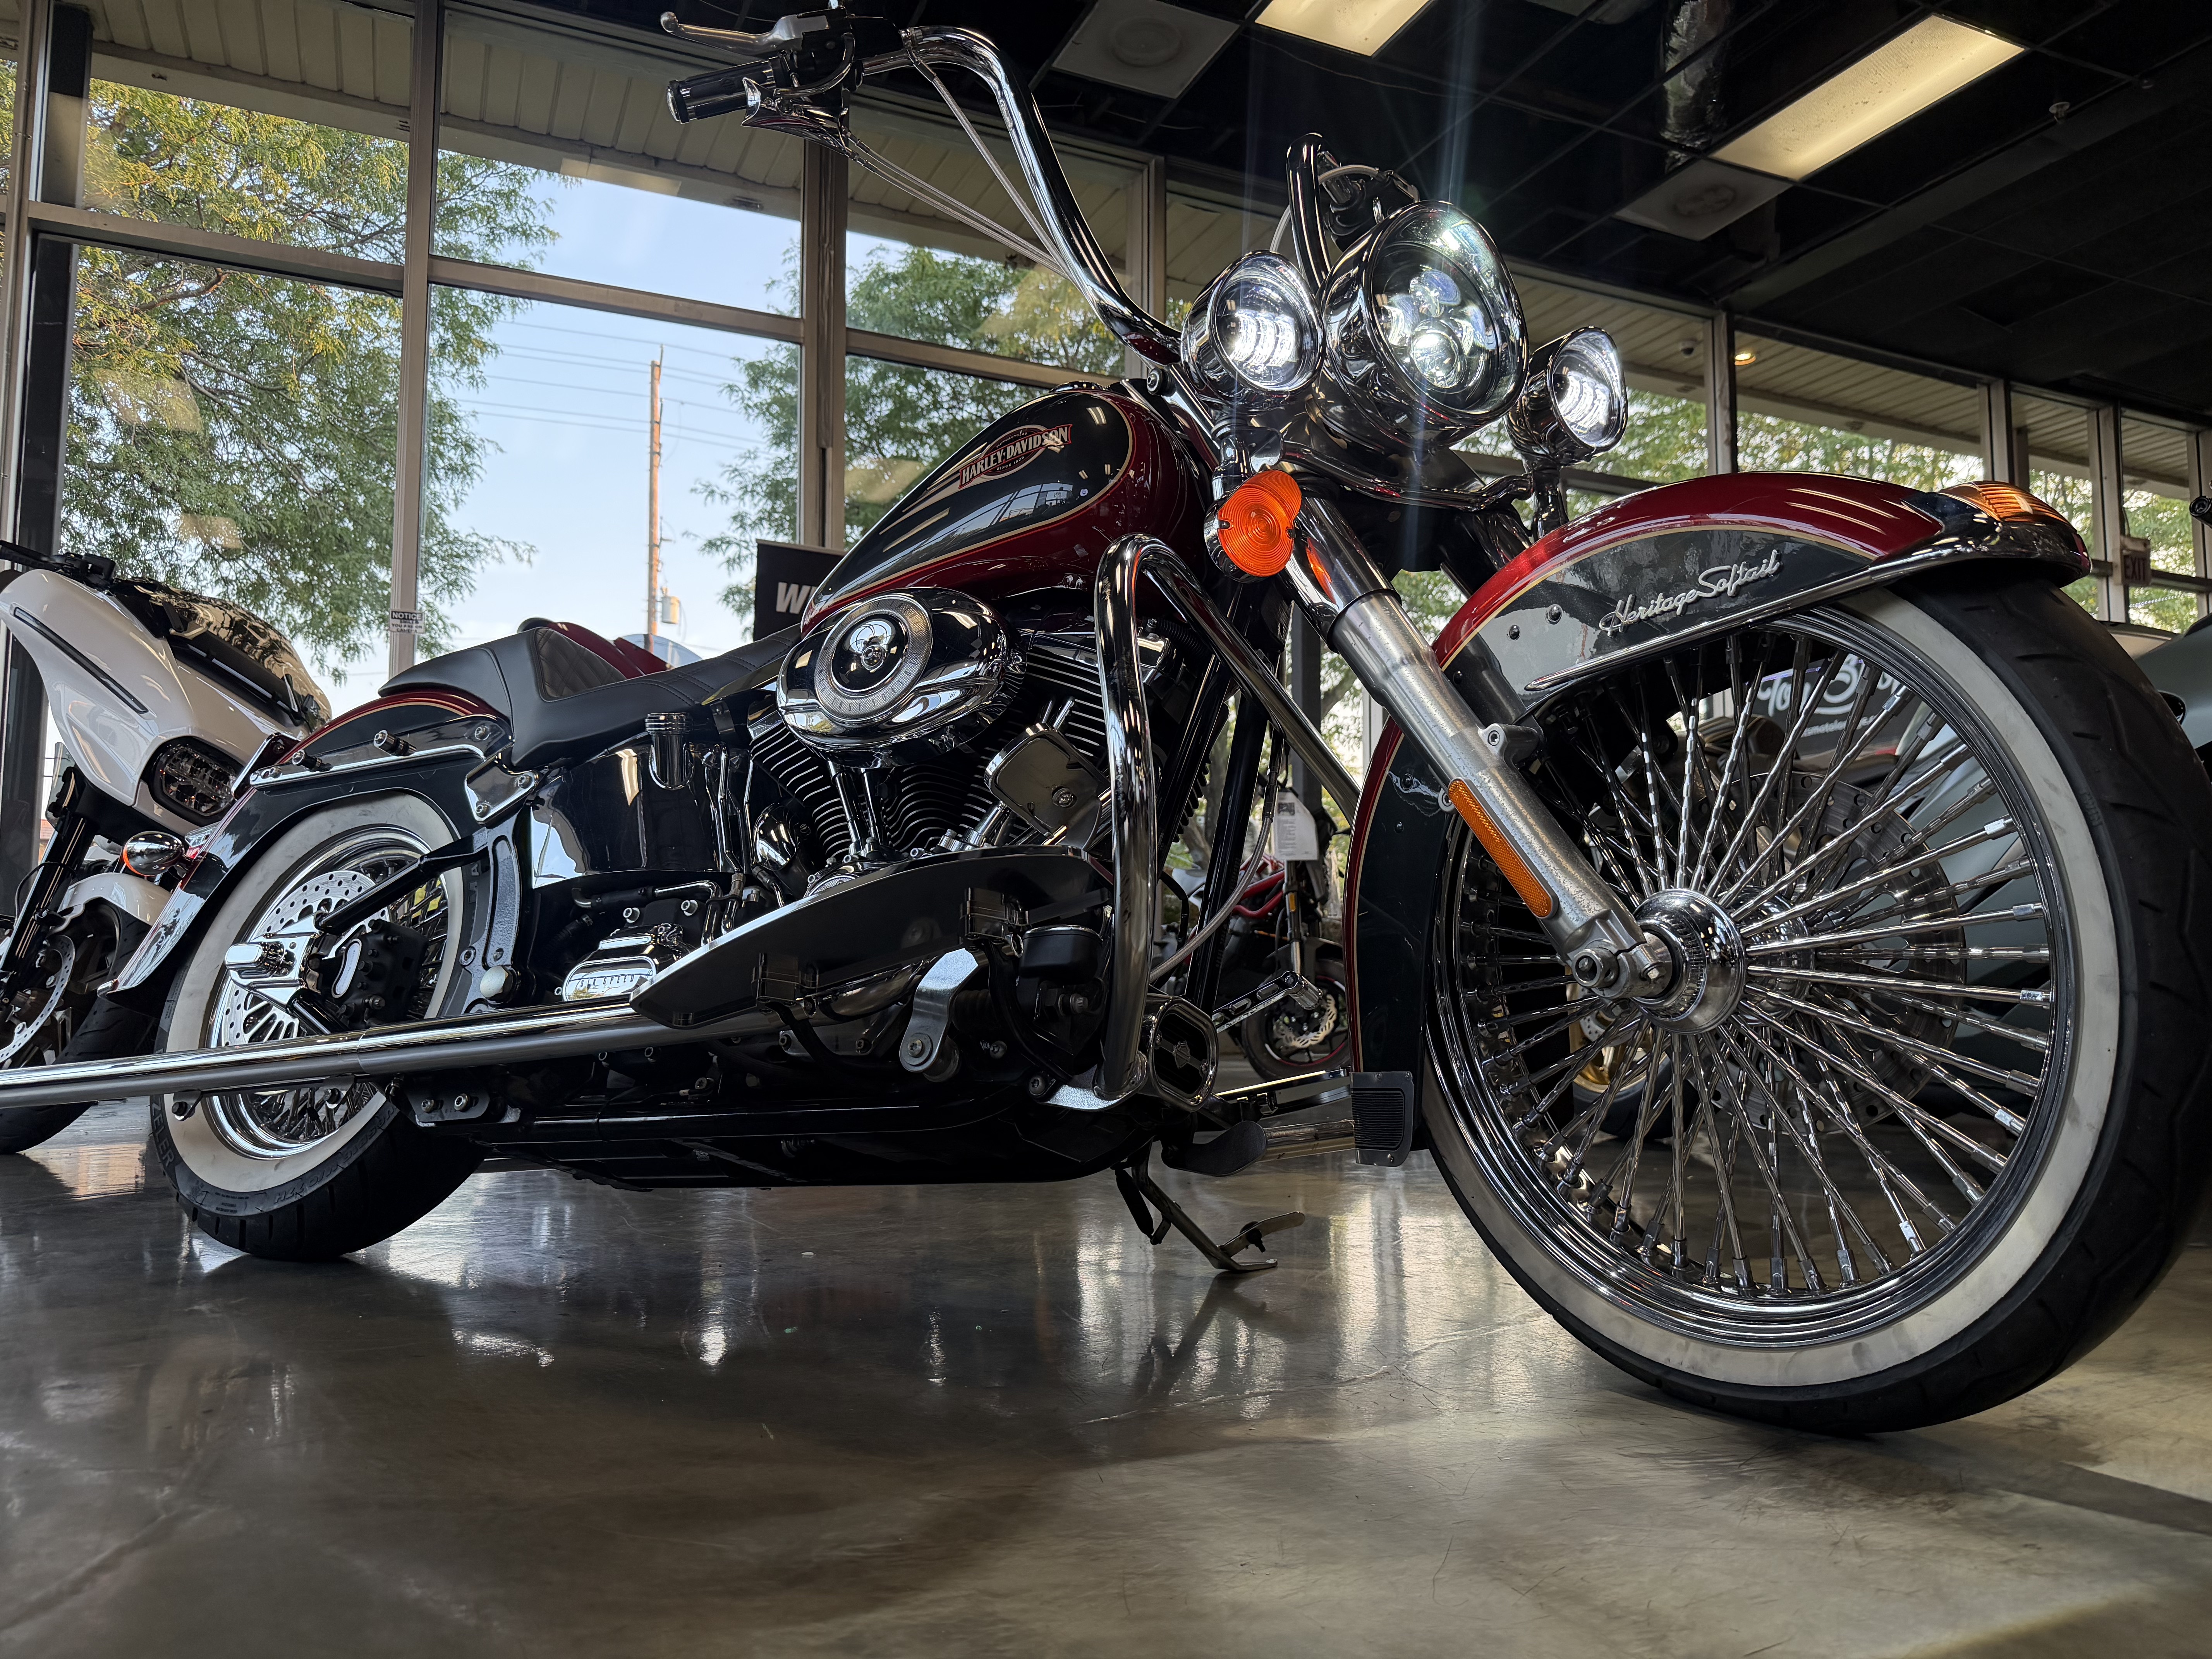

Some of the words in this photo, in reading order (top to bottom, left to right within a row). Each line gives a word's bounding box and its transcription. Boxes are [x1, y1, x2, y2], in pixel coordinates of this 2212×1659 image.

[962, 426, 1068, 484] HARLEY-DAVIDSON
[2124, 555, 2146, 580] EXIT
[1599, 594, 1698, 637] Heritage
[1698, 549, 1782, 597] Softail
[603, 974, 634, 985] SPEED
